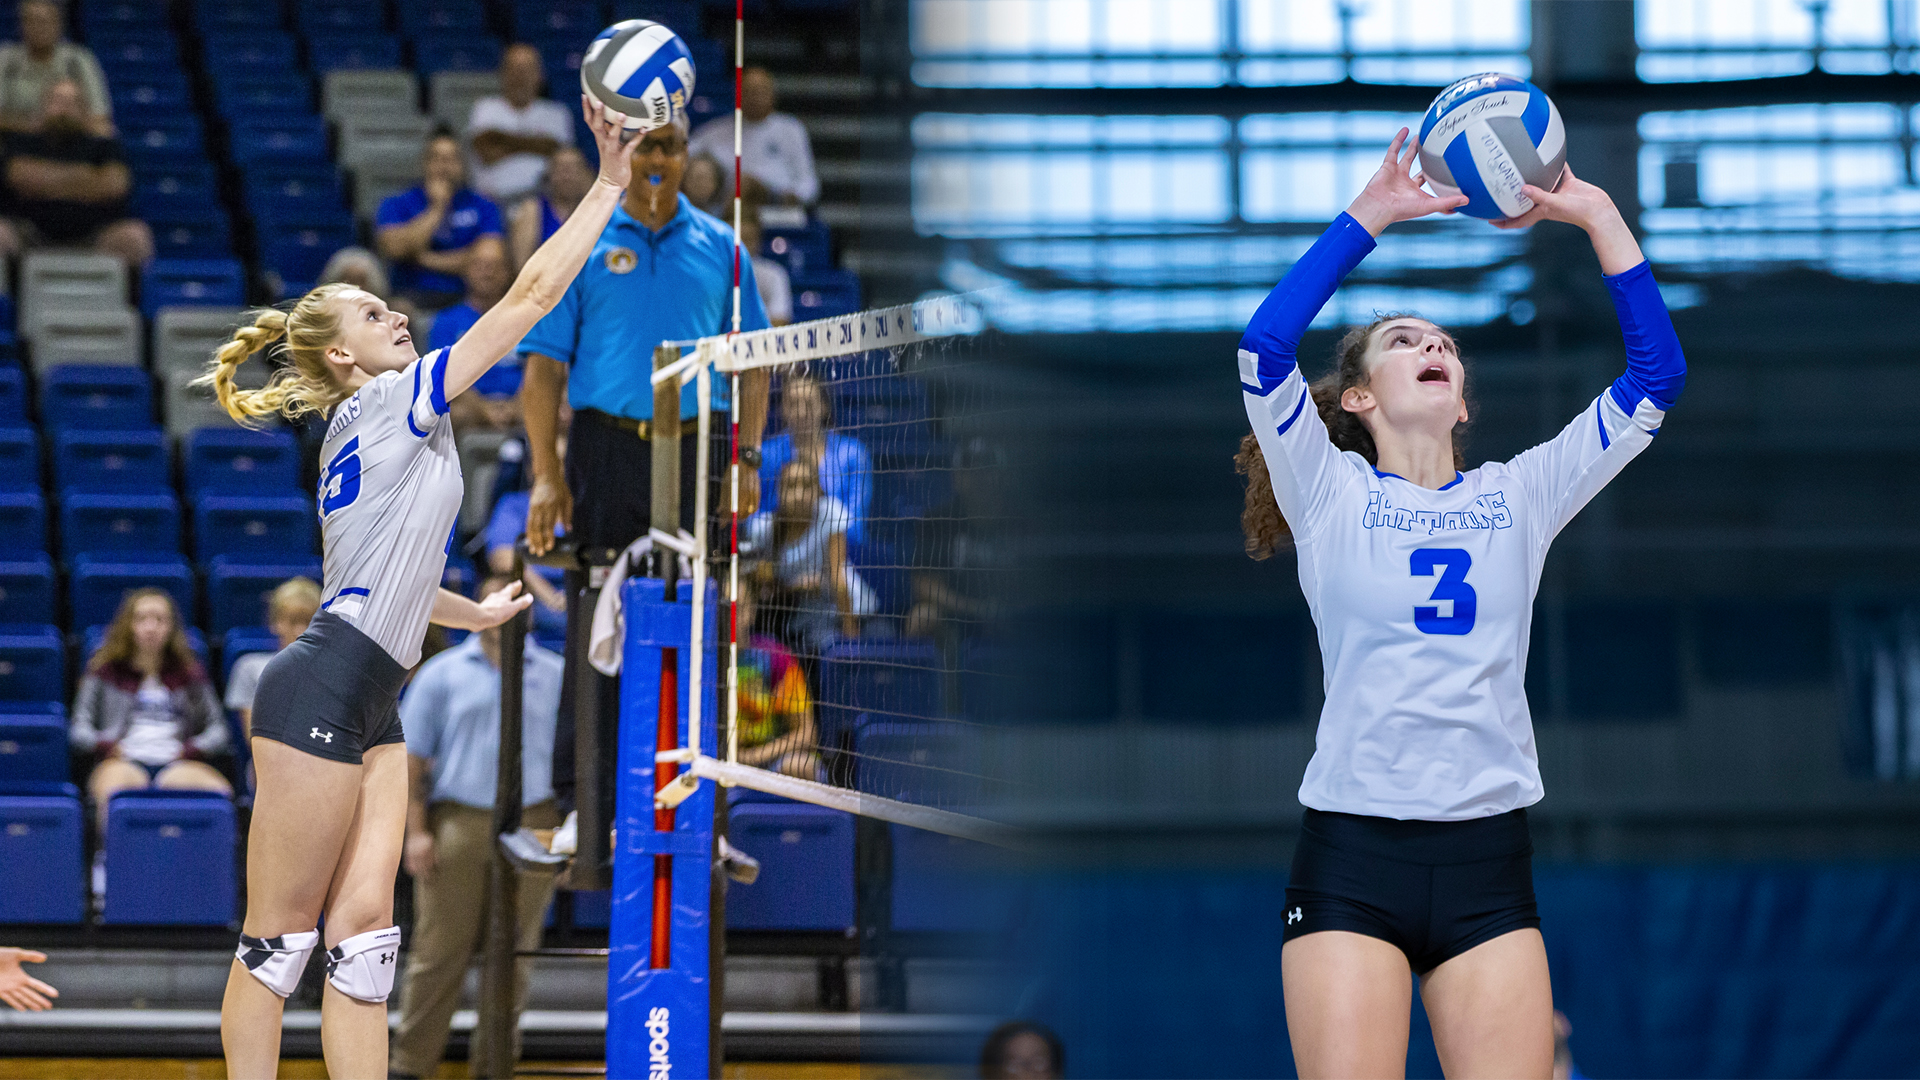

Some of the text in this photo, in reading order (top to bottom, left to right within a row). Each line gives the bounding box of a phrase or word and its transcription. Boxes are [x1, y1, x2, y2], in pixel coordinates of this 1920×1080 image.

[1435, 76, 1500, 119] NCAA
[1437, 95, 1509, 137] Super Touch
[1409, 547, 1477, 636] 3
[644, 1006, 673, 1080] sports
